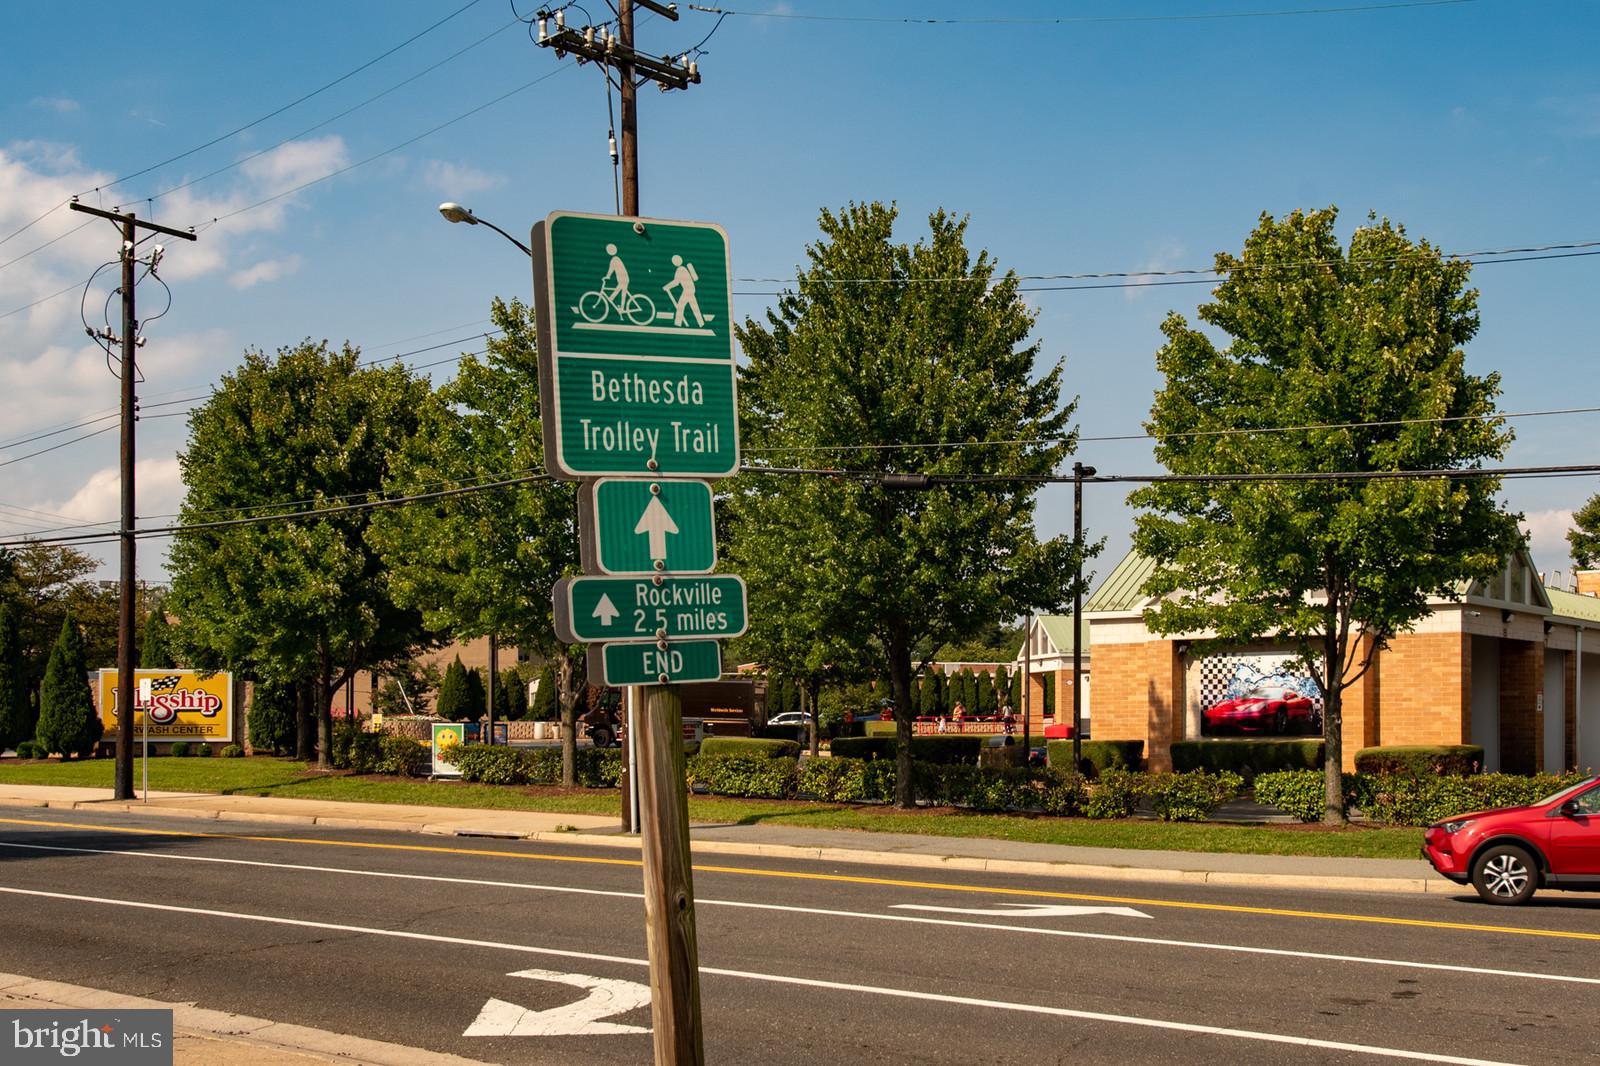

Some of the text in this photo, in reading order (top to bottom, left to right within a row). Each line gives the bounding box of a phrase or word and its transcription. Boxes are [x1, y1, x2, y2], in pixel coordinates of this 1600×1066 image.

[591, 370, 704, 405] Bethesda
[579, 419, 720, 461] Trolley Trail
[635, 582, 722, 607] Rockville
[633, 608, 728, 633] 2.5 miles
[642, 650, 684, 675] END
[112, 688, 220, 723] lagship
[171, 726, 214, 734] CENTER
